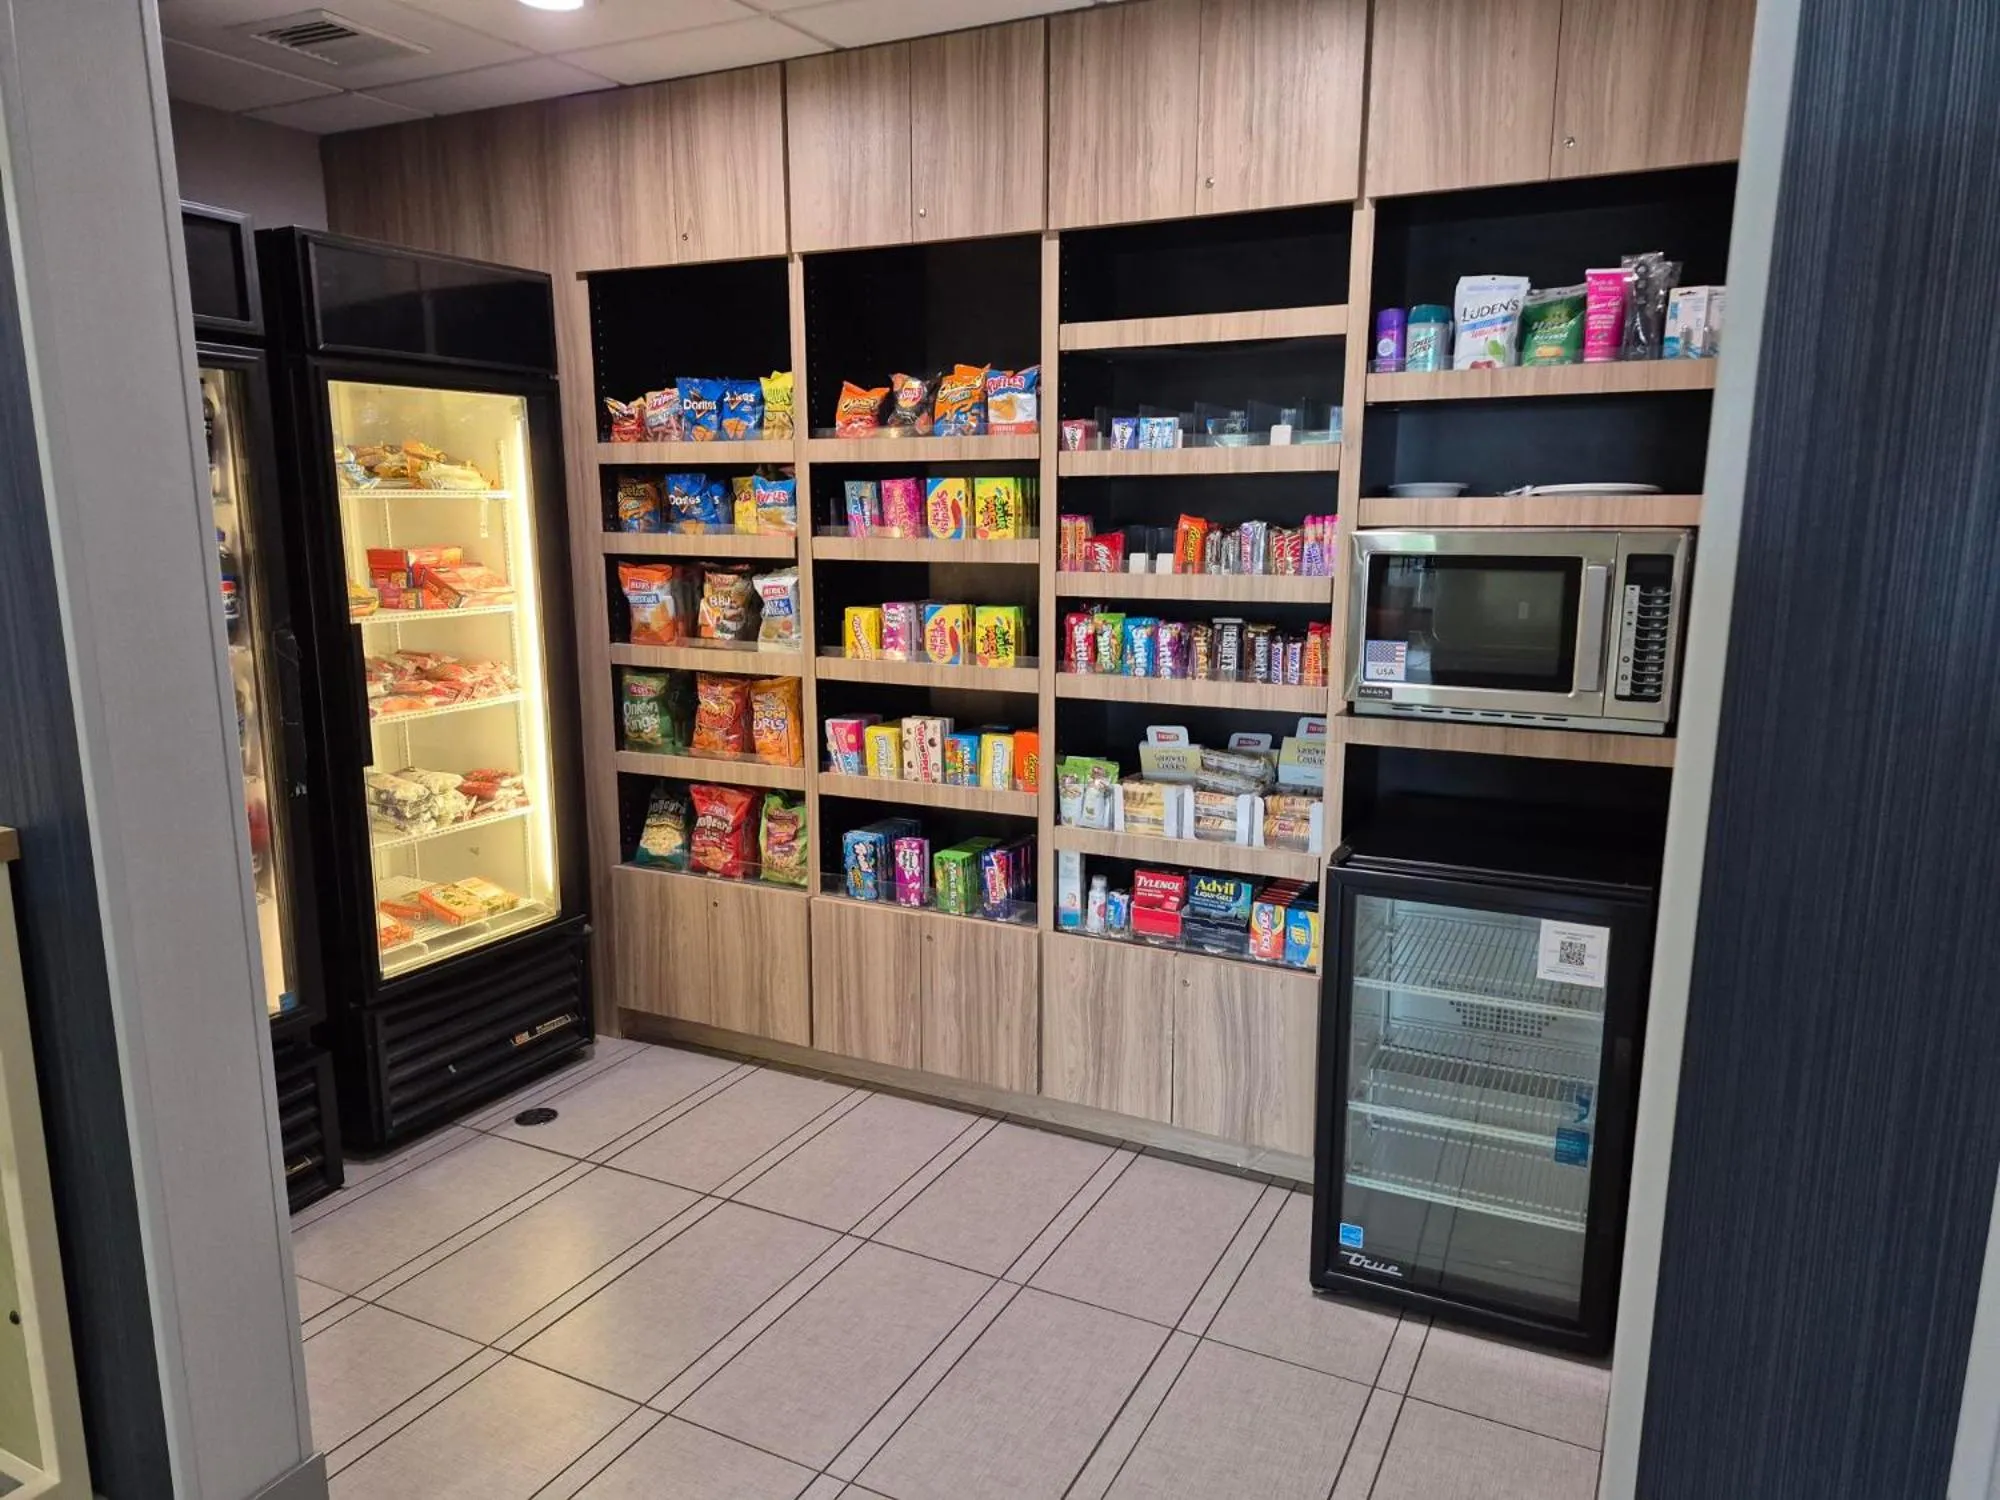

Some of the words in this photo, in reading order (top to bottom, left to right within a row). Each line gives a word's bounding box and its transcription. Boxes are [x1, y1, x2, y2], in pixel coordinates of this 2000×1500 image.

[1462, 299, 1520, 322] LUDEN'S
[683, 399, 717, 412] Doritos
[930, 501, 940, 526] Fish
[936, 490, 949, 534] Swedish
[996, 497, 1006, 530] SOUR
[929, 627, 939, 651] Fish
[934, 617, 947, 660] Swedish
[997, 624, 1007, 657] SOUR
[1074, 623, 1088, 674] Skittles
[1132, 627, 1147, 676] Skittle
[1221, 625, 1237, 671] HERSHEY'S
[1159, 627, 1172, 680] Skittle
[1376, 667, 1395, 676] USA
[624, 701, 658, 717] Onion
[1297, 755, 1325, 765] Cookie
[949, 862, 957, 888] Mike
[988, 867, 999, 903] CRUNCH
[1136, 875, 1180, 891] TYLENOL
[1195, 878, 1234, 896] Advil
[1340, 1251, 1403, 1277] True
